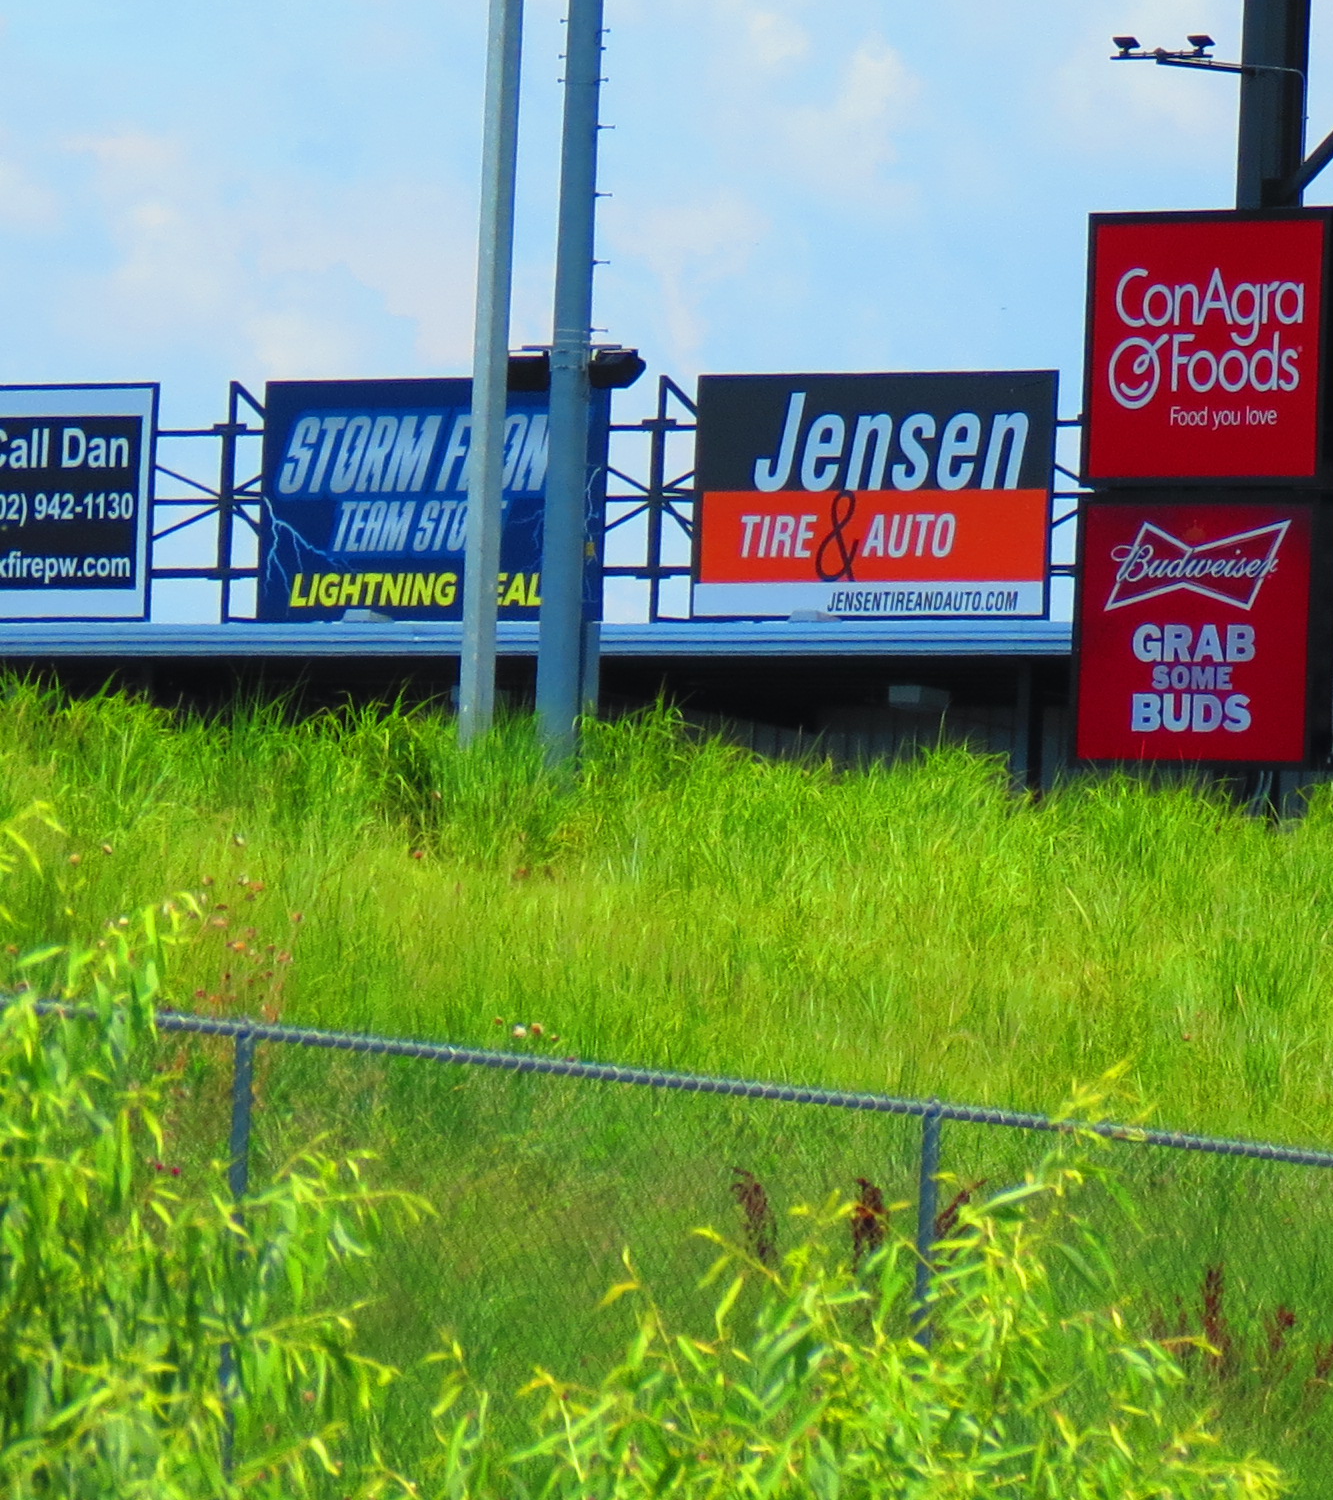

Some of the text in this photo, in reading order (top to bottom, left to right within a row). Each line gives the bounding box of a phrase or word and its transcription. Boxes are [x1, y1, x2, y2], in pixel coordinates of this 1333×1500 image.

[1116, 267, 1305, 347] ConAgra
[1171, 331, 1300, 393] Foods
[1170, 405, 1278, 431] Food you love
[61, 428, 129, 468] Dan
[278, 415, 443, 494] STORM
[754, 392, 1029, 492] Jensen
[34, 492, 134, 521] 942-1130
[332, 501, 508, 552] TEAM STO
[740, 490, 957, 582] TIRE & AUTO
[1110, 544, 1278, 582] Budweiser
[290, 572, 542, 607] LIGHTNING EAL
[827, 590, 1019, 613] JENSENTIREANDAUTO.COM
[1132, 623, 1256, 663] GRAB
[1152, 665, 1233, 690] SOME
[1131, 693, 1252, 732] BUDS
